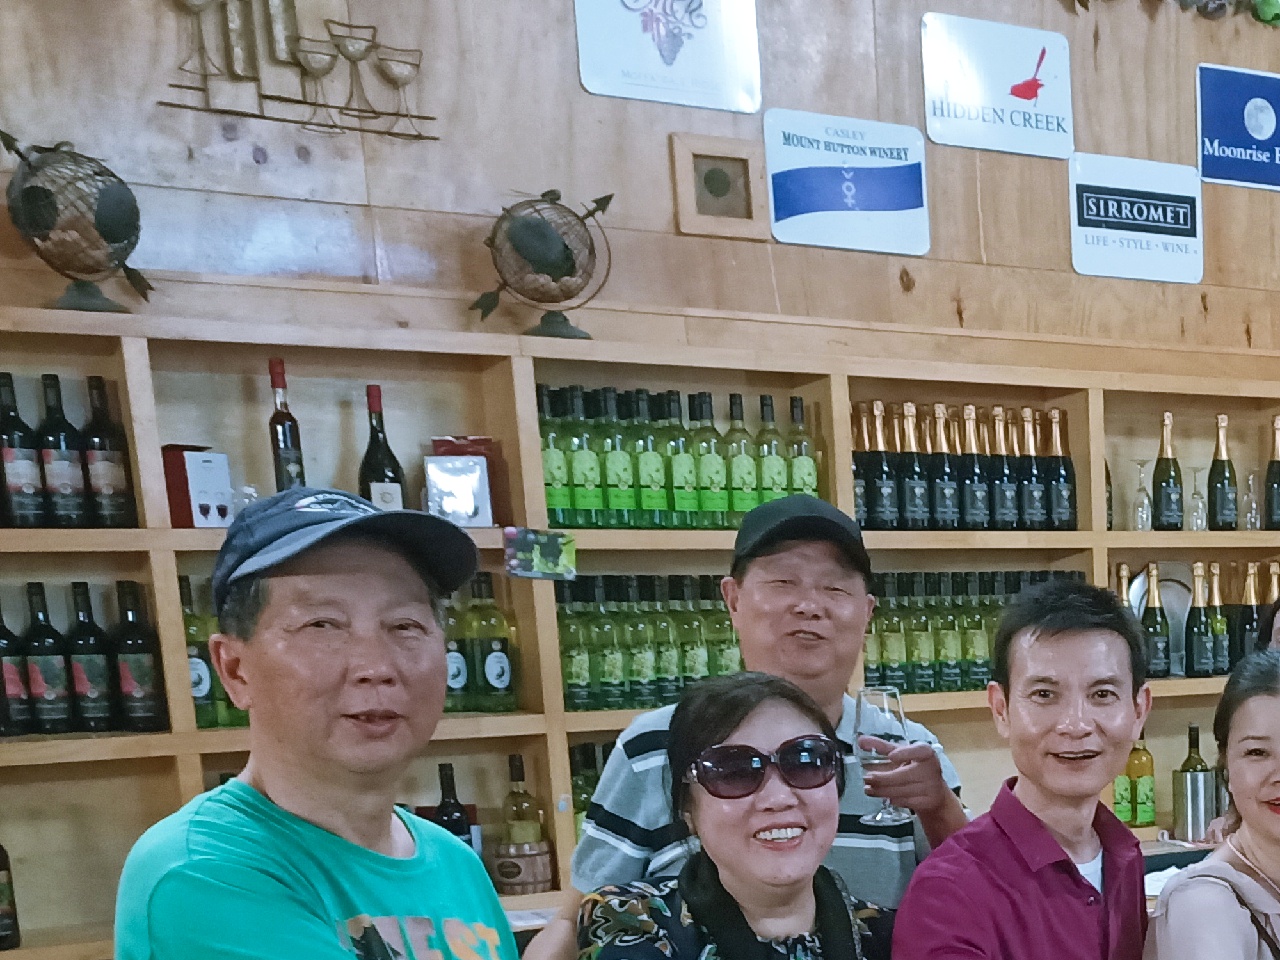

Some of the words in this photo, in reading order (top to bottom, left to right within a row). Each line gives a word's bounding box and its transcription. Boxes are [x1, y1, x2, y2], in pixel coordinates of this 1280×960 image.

[932, 99, 1004, 124] HIDDEN
[1010, 110, 1068, 134] CREEK
[781, 131, 821, 151] MOUNT
[823, 140, 867, 157] HUTTON
[868, 146, 909, 161] WINERY
[824, 126, 867, 141] CASLEY
[1203, 138, 1271, 164] Moonrise
[1088, 198, 1188, 224] SIRROMET
[1084, 234, 1109, 247] LIFE
[1118, 237, 1152, 251] STYLE
[1161, 241, 1190, 254] WINE
